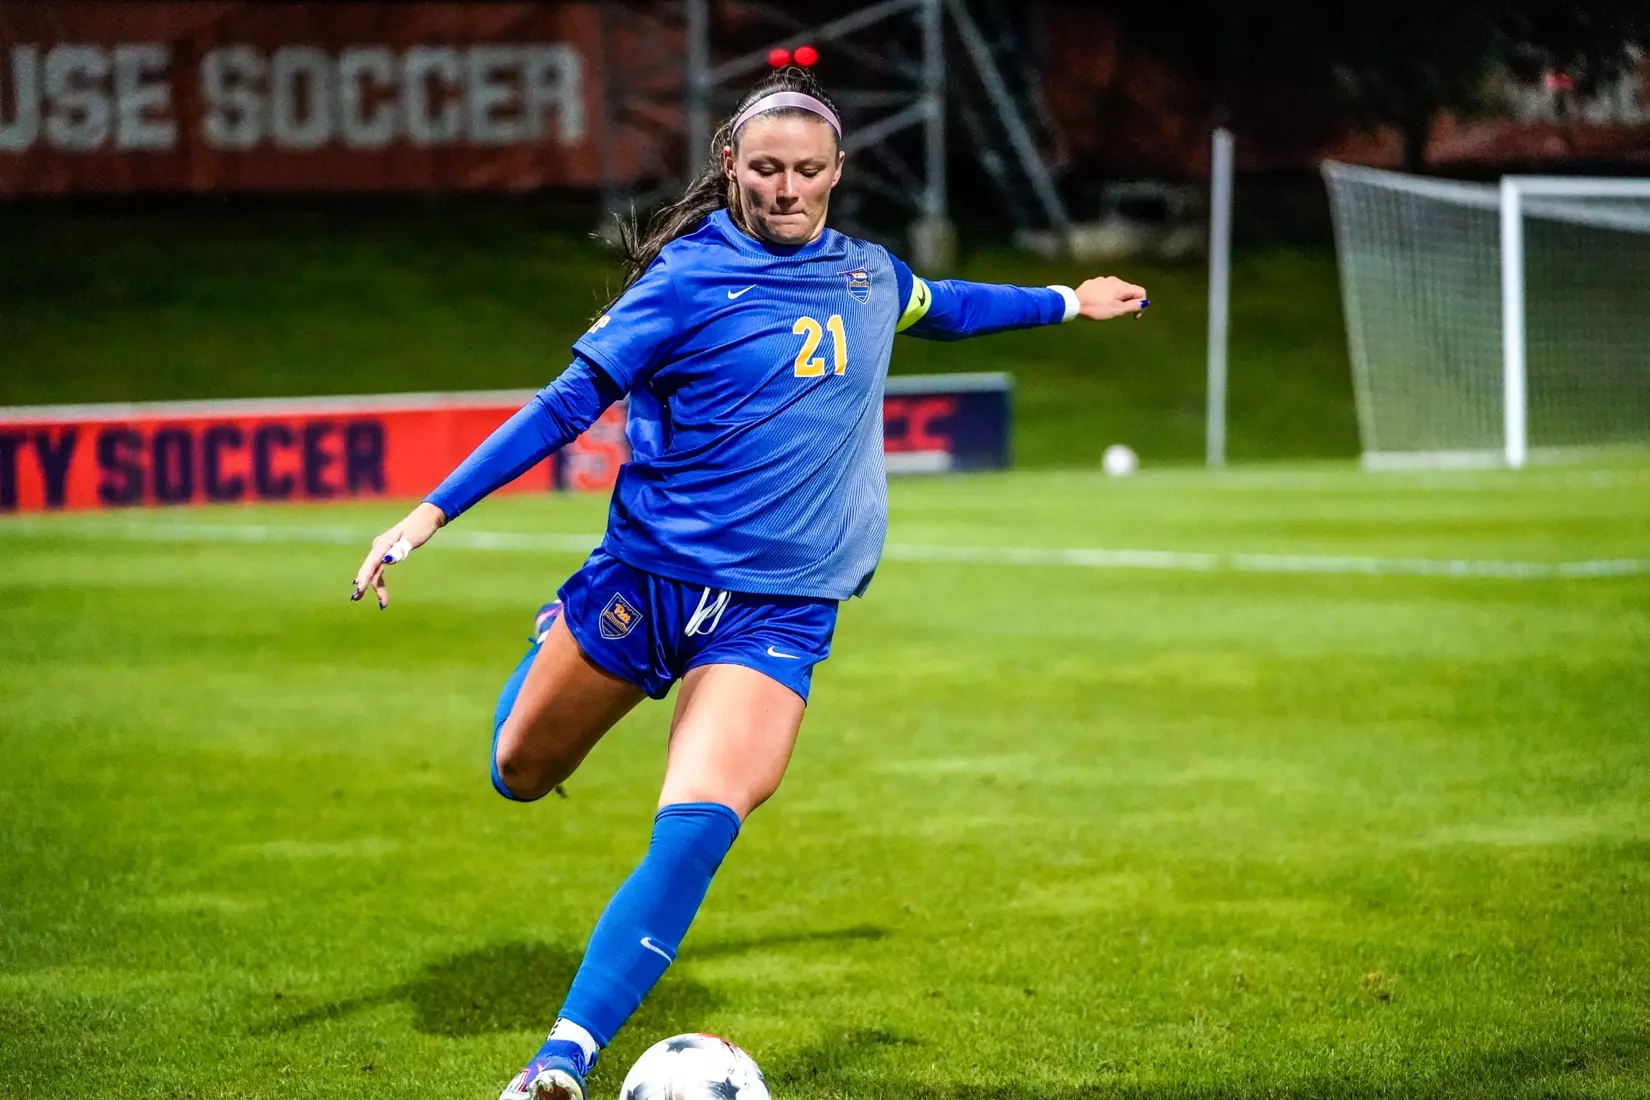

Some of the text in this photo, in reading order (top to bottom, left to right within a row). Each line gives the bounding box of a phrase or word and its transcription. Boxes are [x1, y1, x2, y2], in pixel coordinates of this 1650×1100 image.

[200, 44, 583, 150] SOCCER
[793, 314, 848, 377] 21
[97, 420, 387, 505] SOCCER
